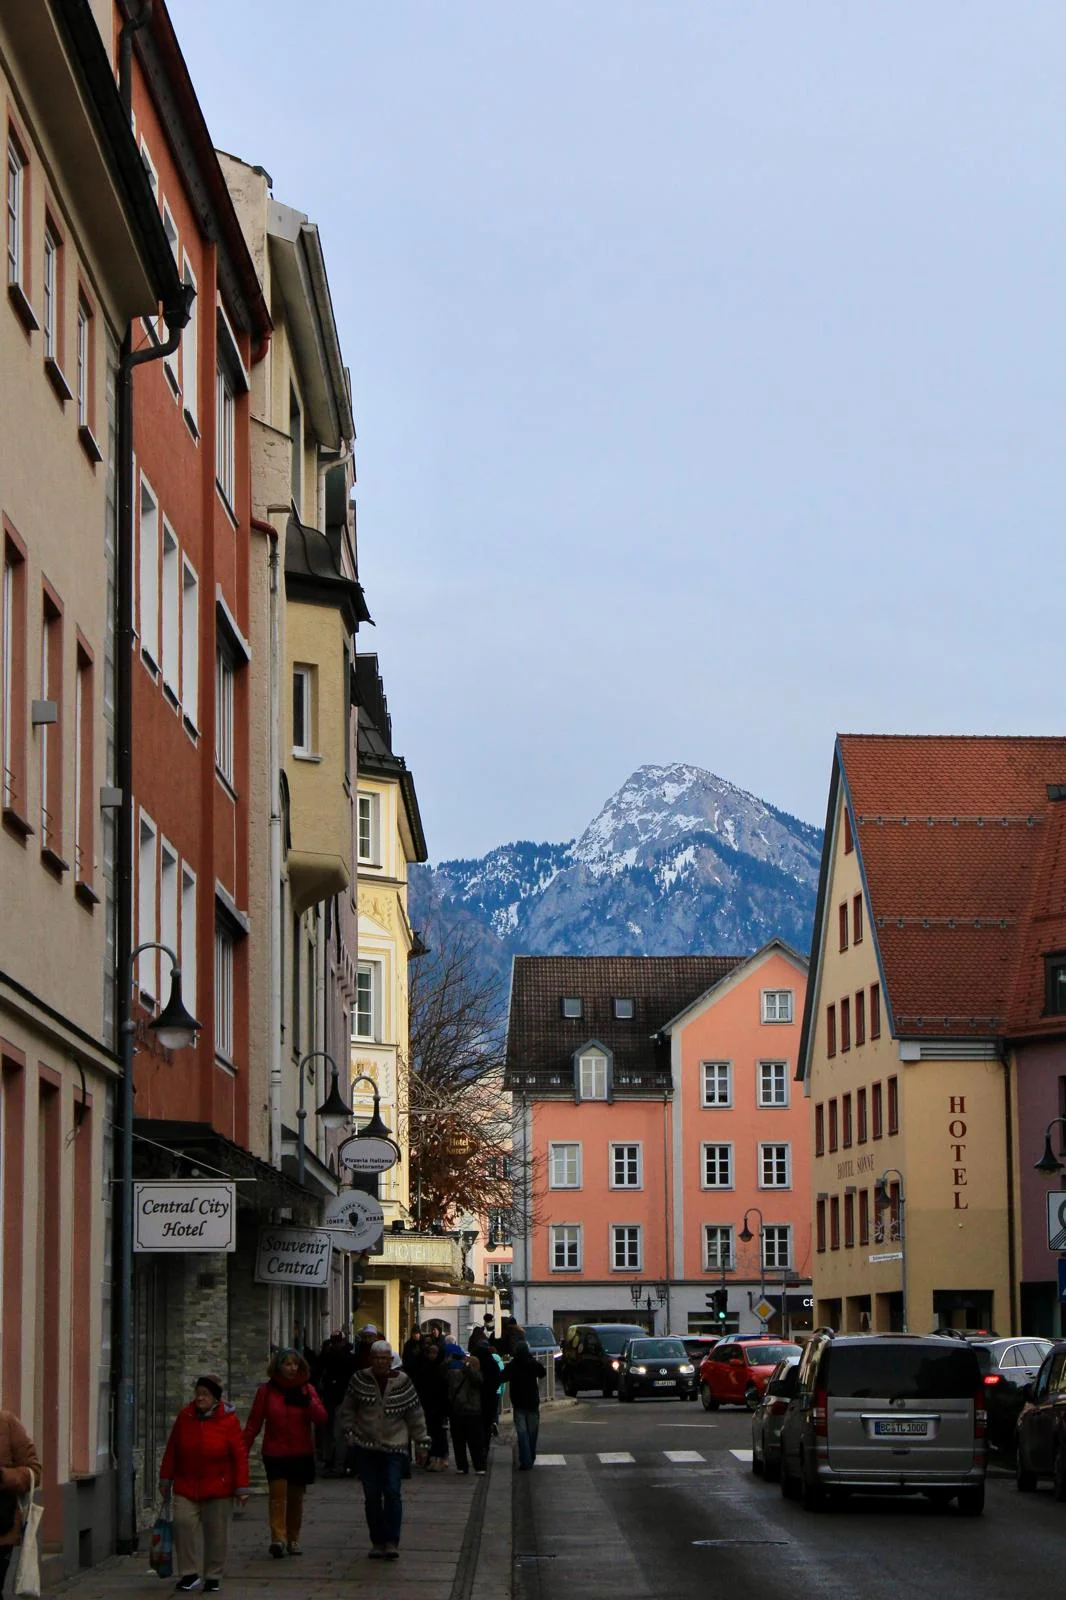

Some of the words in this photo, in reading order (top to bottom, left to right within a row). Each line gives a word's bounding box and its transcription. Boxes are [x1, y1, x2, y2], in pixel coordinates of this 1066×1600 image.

[948, 1095, 969, 1210] HOTEL
[837, 1159, 855, 1180] HOTEL
[142, 1197, 198, 1215] Central
[199, 1199, 230, 1218] City
[161, 1220, 208, 1237] Hotel
[262, 1235, 328, 1256] Souvenir
[267, 1256, 324, 1276] Central
